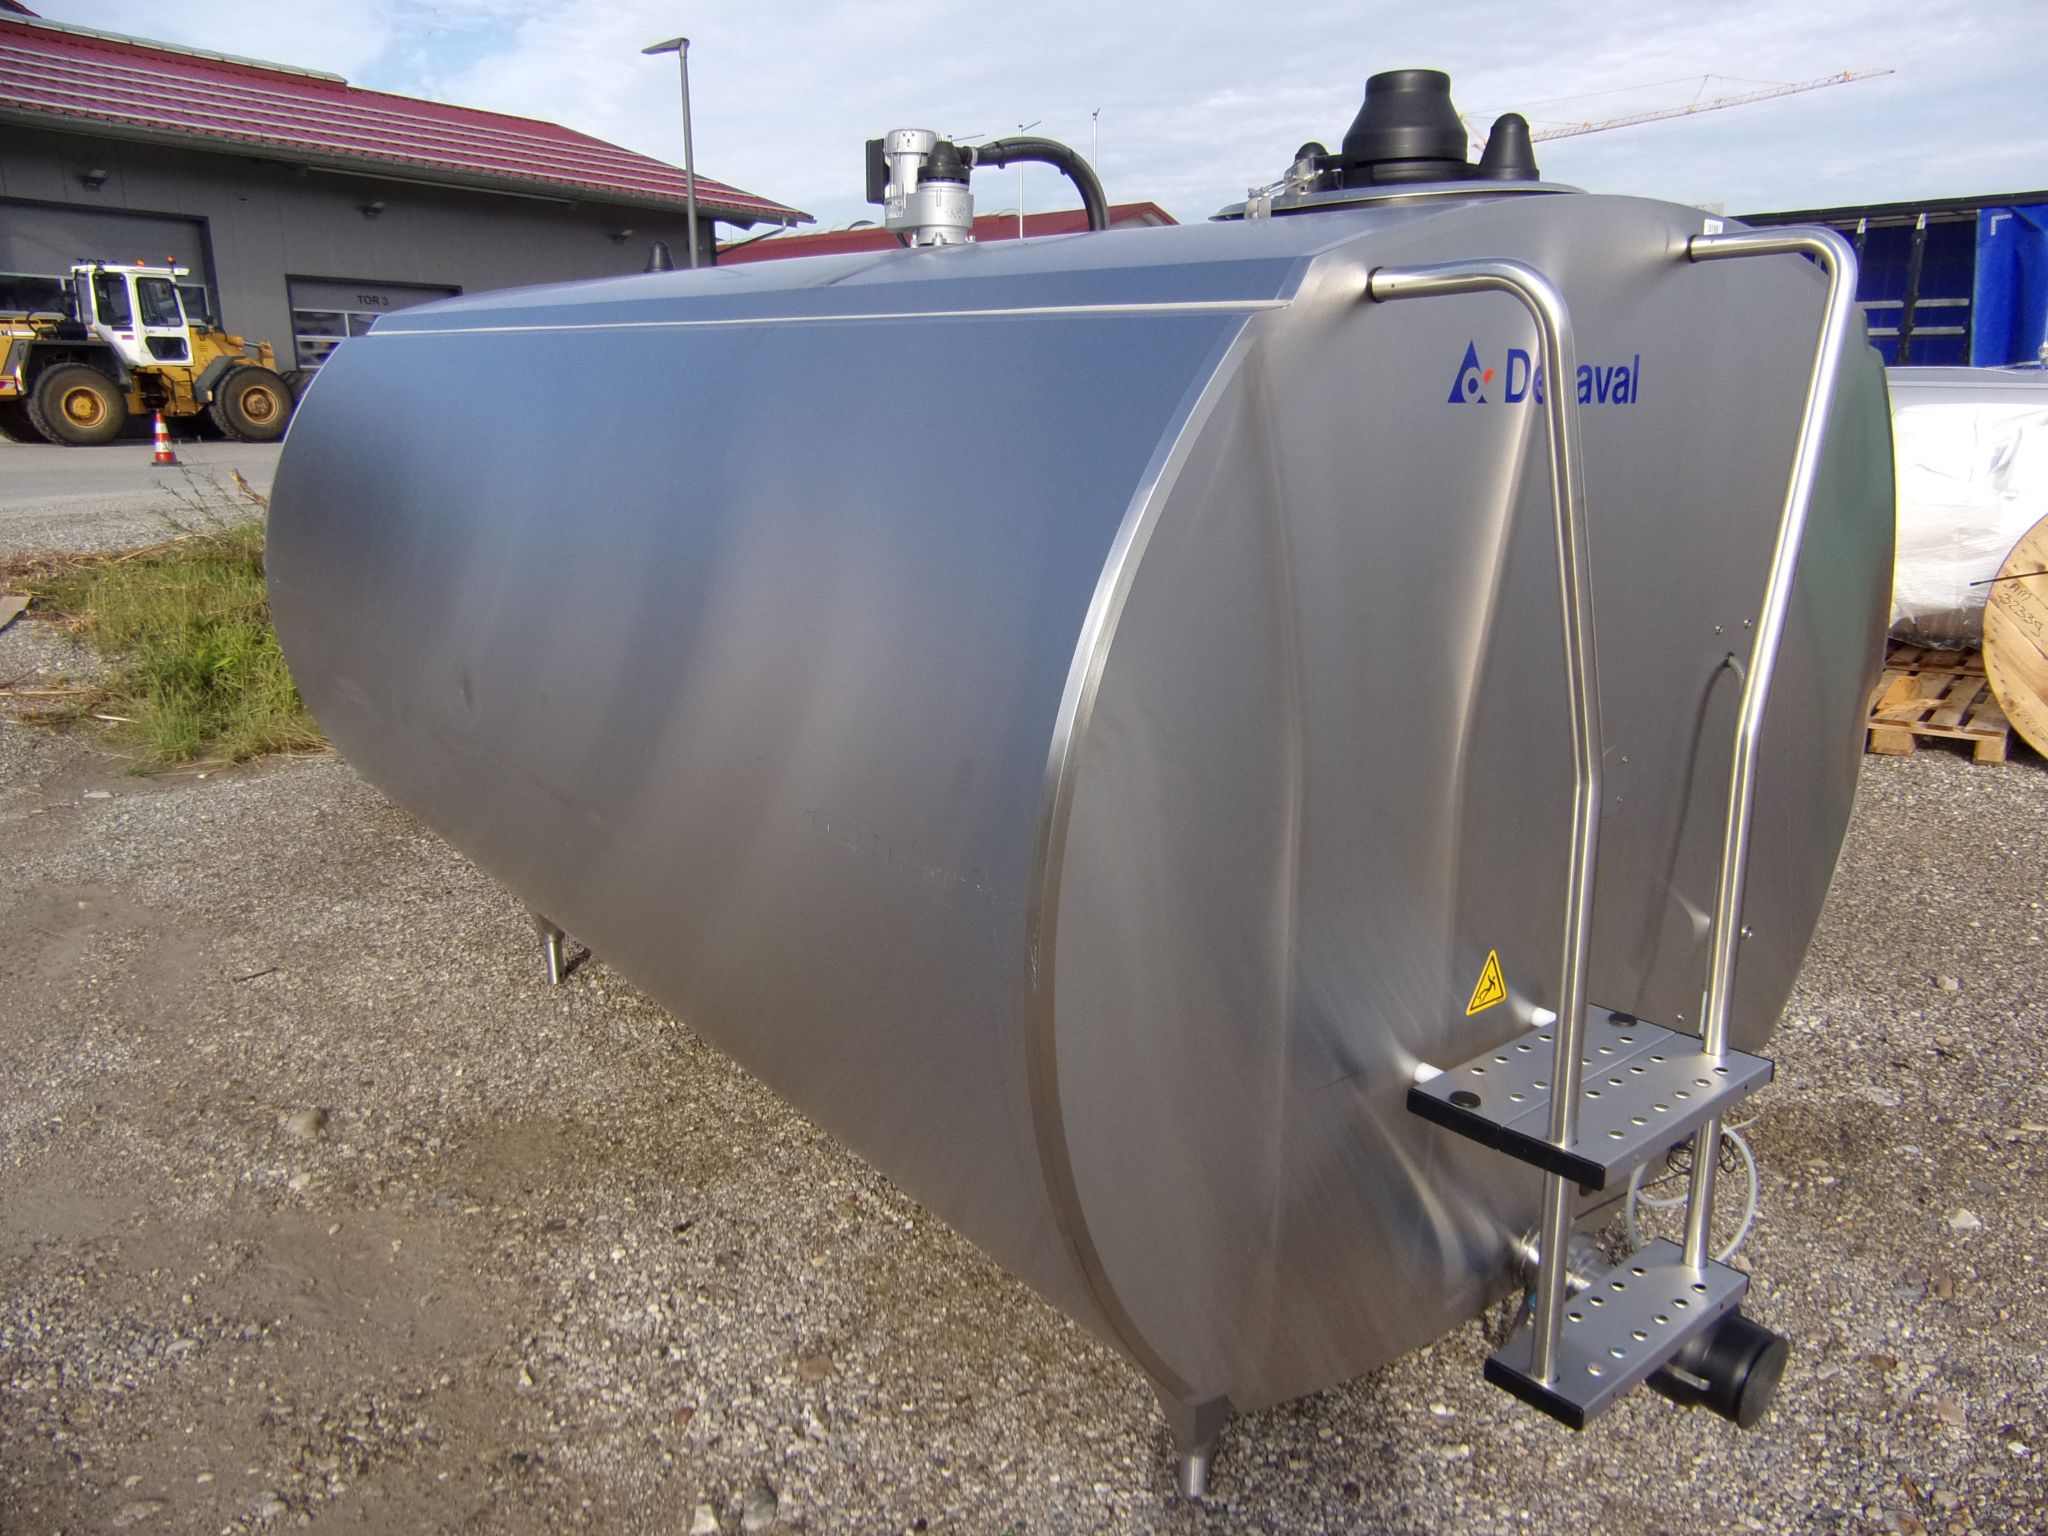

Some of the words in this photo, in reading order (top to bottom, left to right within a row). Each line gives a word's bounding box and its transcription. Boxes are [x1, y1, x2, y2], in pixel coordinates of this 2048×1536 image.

[357, 295, 380, 305] TOR
[382, 296, 389, 306] 3
[1504, 348, 1640, 405] Deaval
